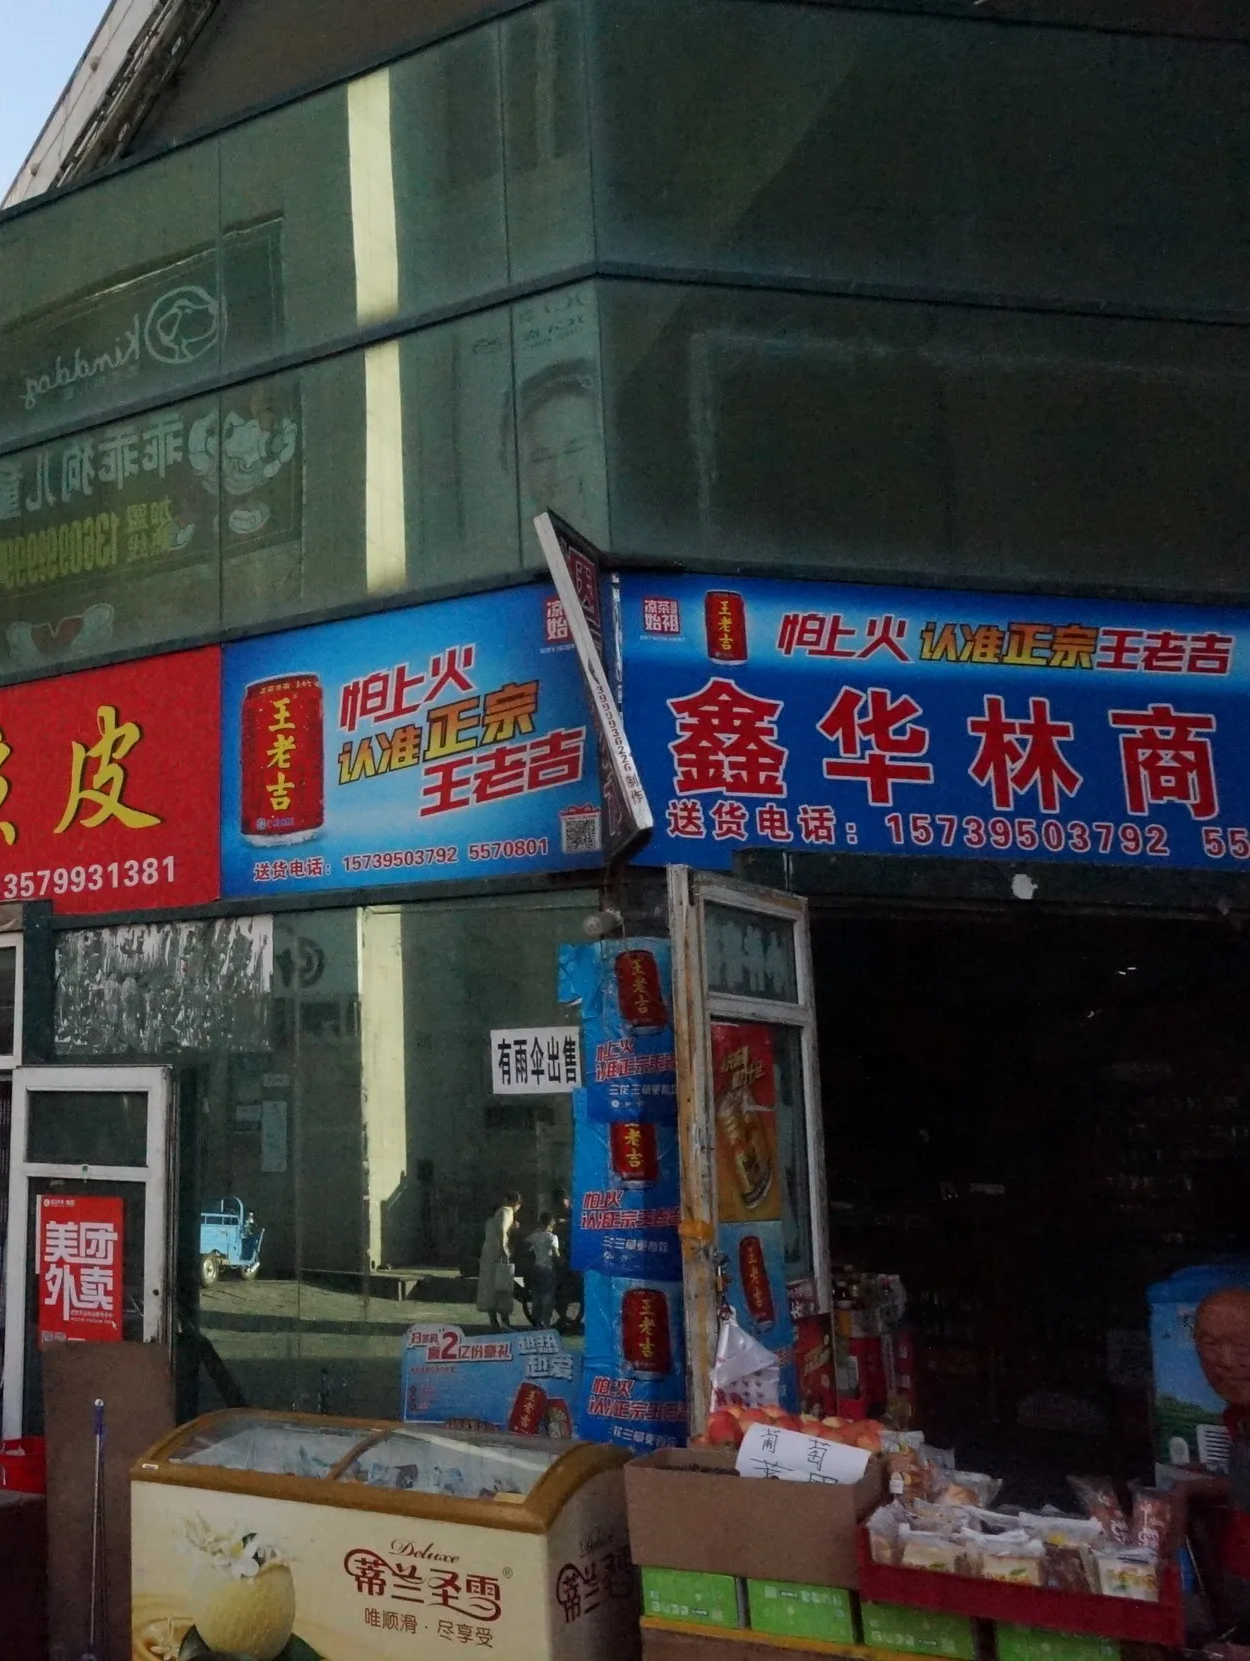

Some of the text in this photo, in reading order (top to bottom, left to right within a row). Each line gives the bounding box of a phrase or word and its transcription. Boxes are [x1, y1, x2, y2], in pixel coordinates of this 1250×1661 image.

[718, 600, 734, 650] 王老吉
[775, 612, 1237, 677] 怕上火 认准正宗王老吉
[338, 643, 476, 733] 怕上火
[265, 696, 297, 811] 王老吉
[337, 679, 540, 786] 认准正宗
[666, 676, 1220, 822] 鑫华林商
[419, 725, 587, 818] 王老吉
[254, 836, 550, 883] 送货电话： 15739503792 5570801
[883, 811, 1171, 857] 15739503792
[631, 959, 650, 1015] 王老吉
[497, 1035, 578, 1086] 有雨伞出售
[44, 1220, 118, 1266] 美团
[44, 1264, 114, 1321] 外卖
[638, 1299, 655, 1358] 王老吉
[390, 1539, 460, 1564] Deluxe
[347, 1552, 501, 1621] 蒂兰圣雪
[363, 1607, 494, 1649] 唯顺滑·尽享受
